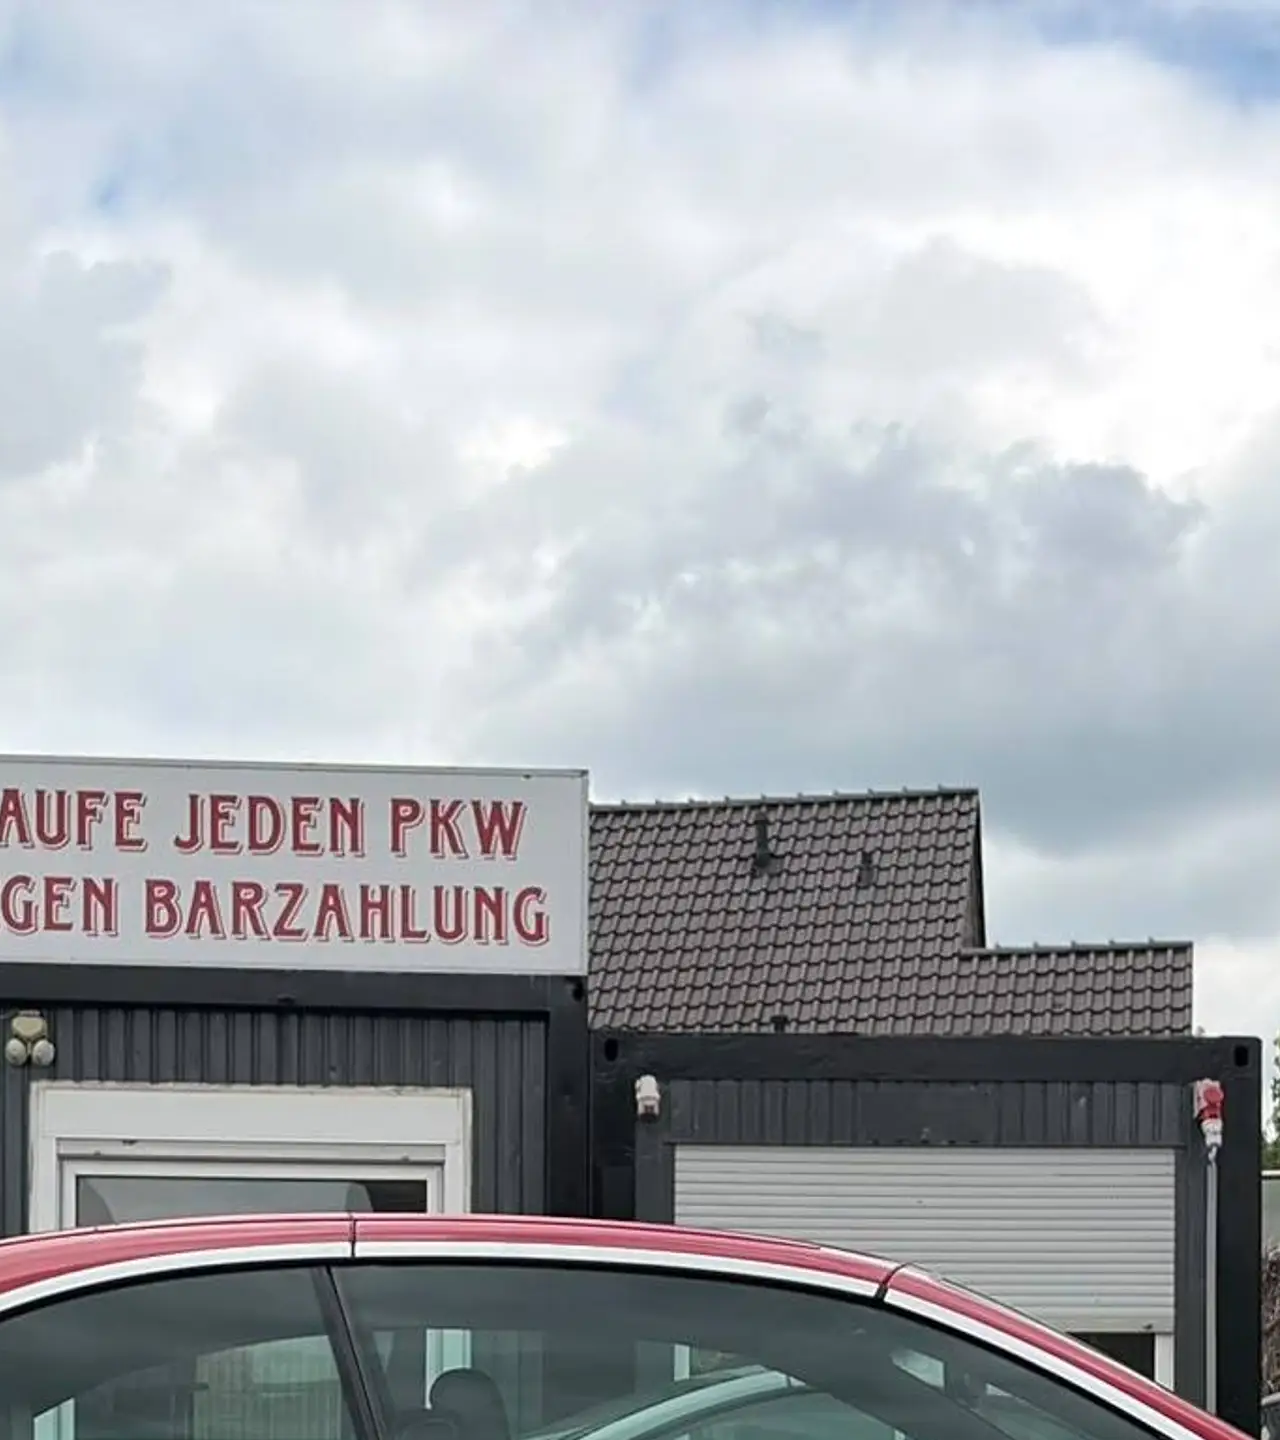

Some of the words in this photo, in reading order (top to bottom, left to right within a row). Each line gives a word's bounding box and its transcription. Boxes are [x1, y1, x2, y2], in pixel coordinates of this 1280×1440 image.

[175, 794, 365, 857] JEDEN
[389, 799, 525, 860] PKW
[144, 878, 550, 947] BARZAHLUNG
